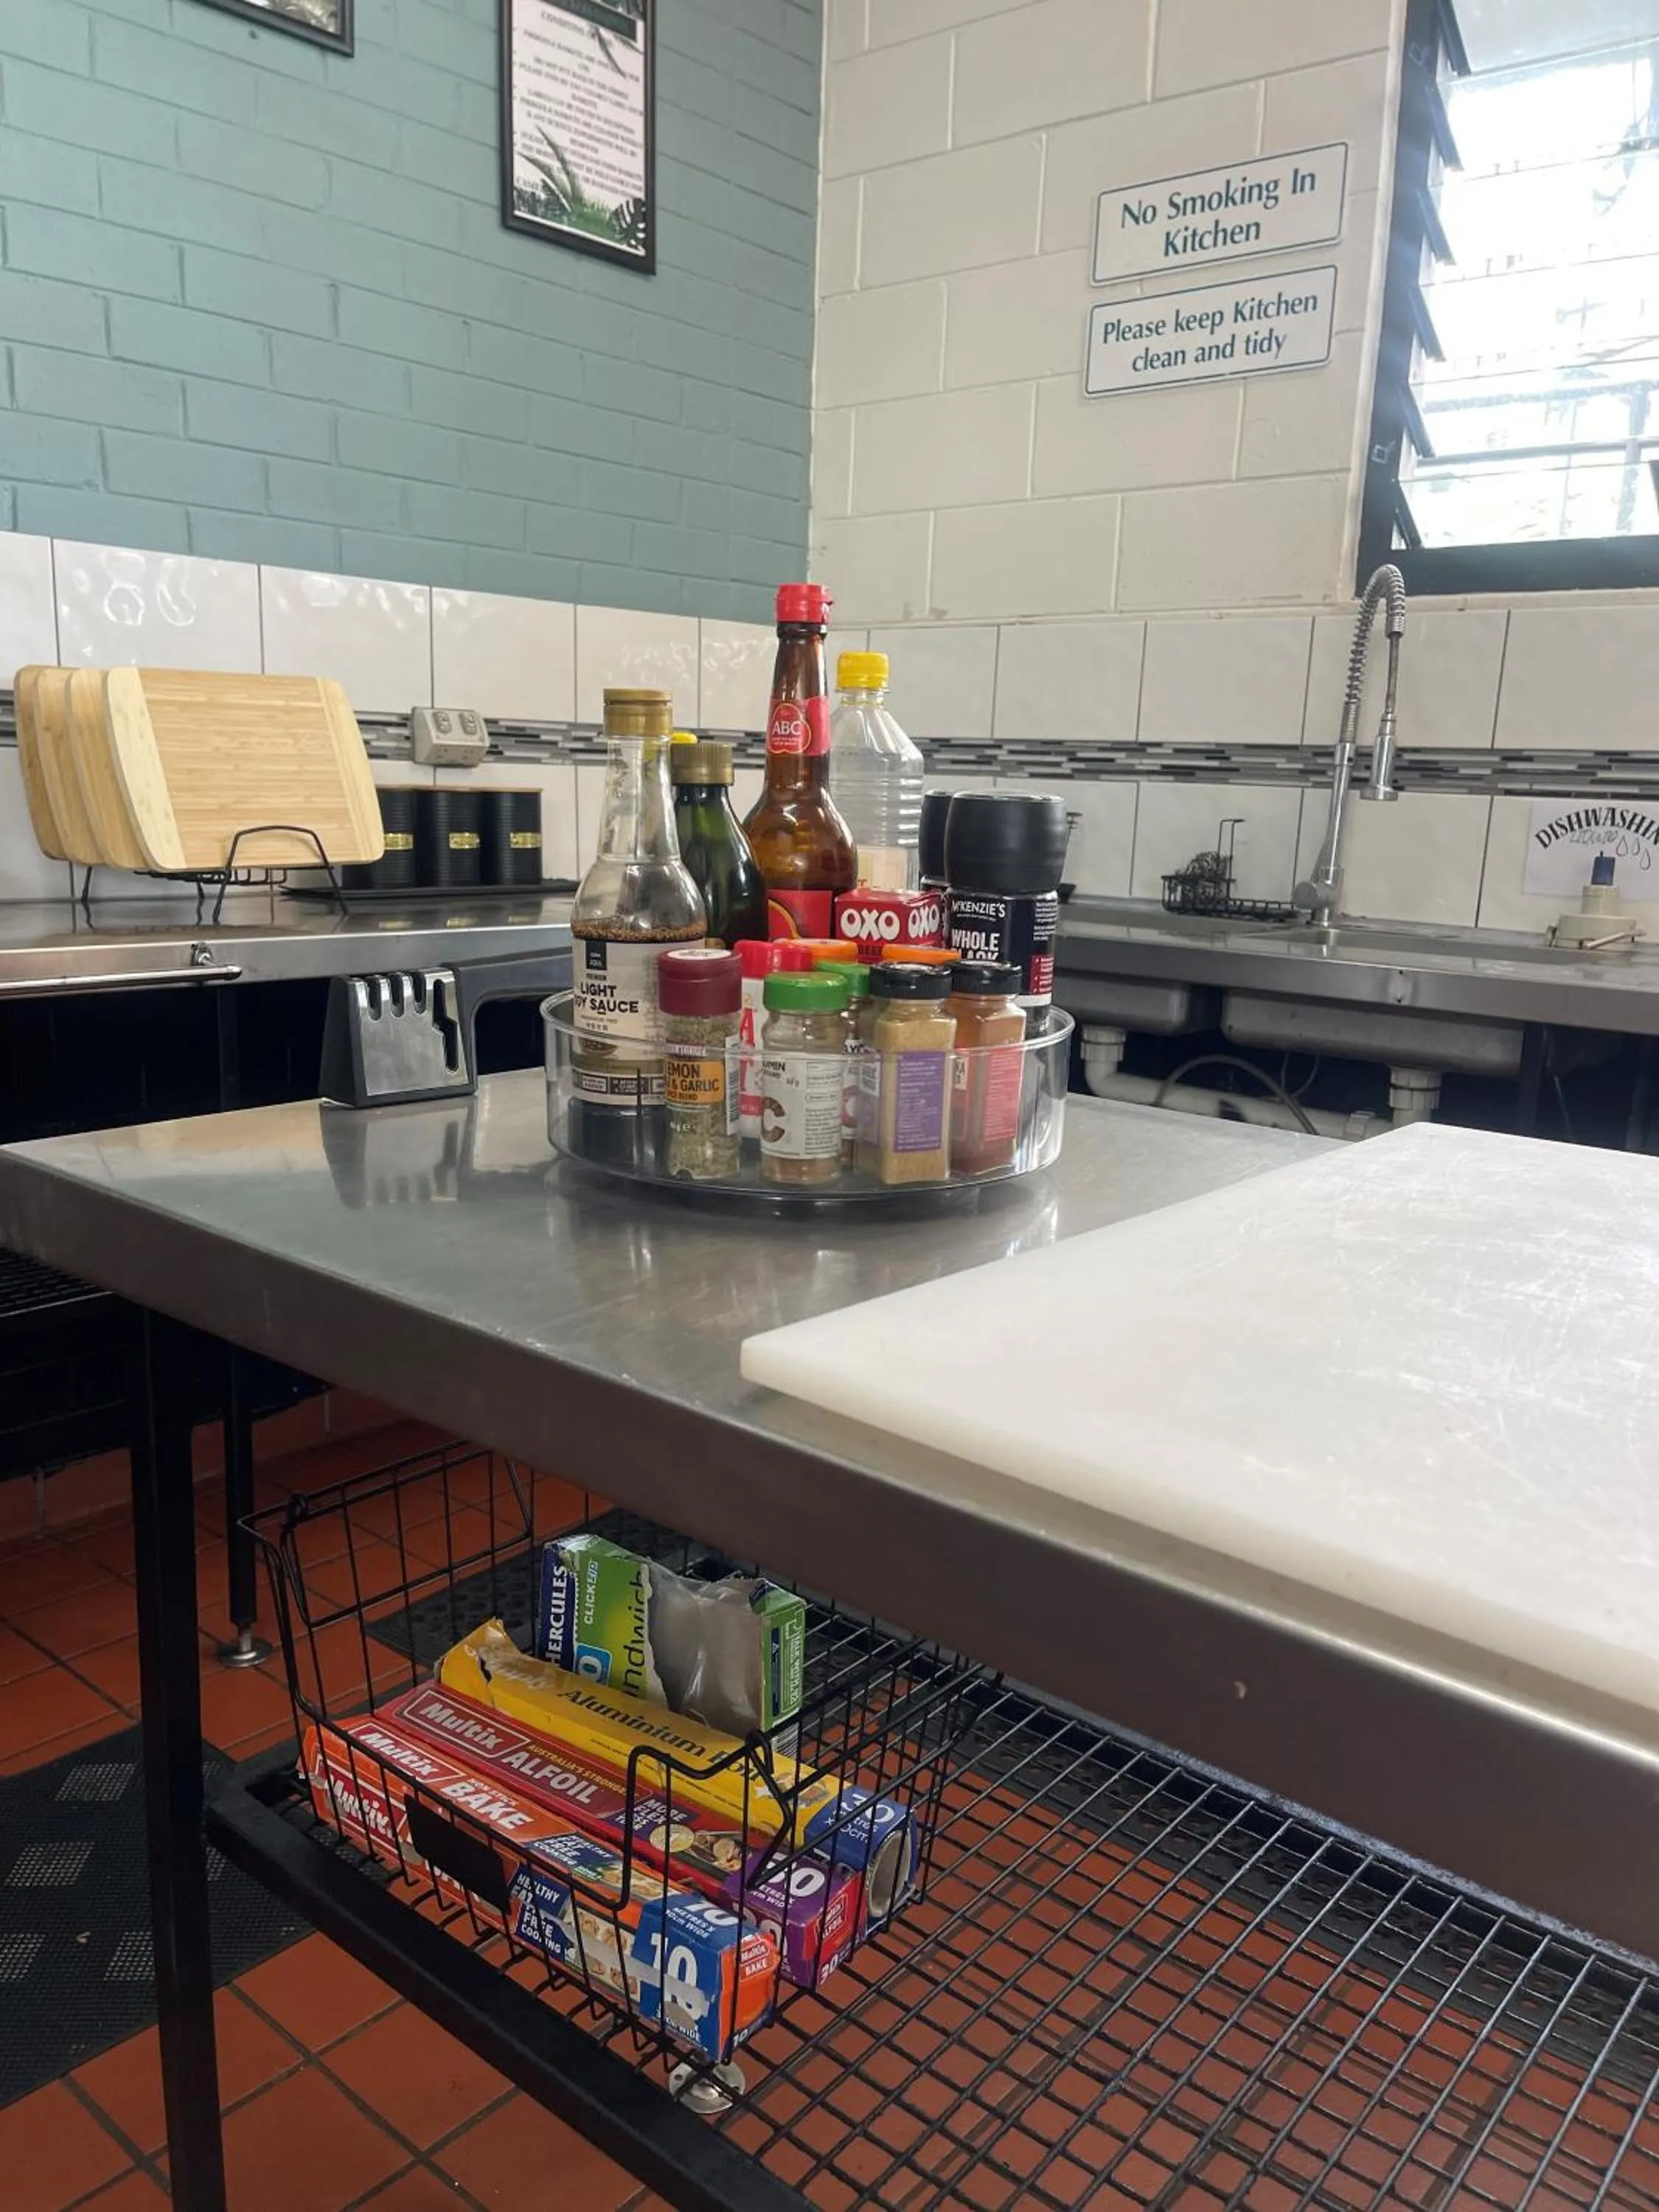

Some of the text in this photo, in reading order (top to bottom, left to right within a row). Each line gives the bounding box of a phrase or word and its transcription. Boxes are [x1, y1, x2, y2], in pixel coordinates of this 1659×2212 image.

[1121, 168, 1316, 229] No Smoking In
[1164, 219, 1261, 257] Kitchen
[1103, 292, 1318, 344] Please keep Kitchen
[1132, 328, 1287, 372] clean and tidy
[773, 720, 801, 735] ABC
[841, 908, 900, 941] OXO
[908, 904, 940, 939] OXO
[952, 929, 1001, 951] WHOLE
[580, 982, 617, 998] LIGHT
[590, 998, 639, 1014] SAUCE
[667, 1062, 700, 1078] EMON
[681, 1079, 720, 1092] GARLIC
[762, 1062, 785, 1072] UMIN
[545, 1565, 567, 1664] HERCULES
[622, 1571, 645, 1697] ndwich
[419, 1703, 504, 1750] Multix
[559, 1688, 706, 1758] Aluminium
[358, 1733, 439, 1776] Multix
[501, 1751, 599, 1804] ALFOIL
[440, 1781, 535, 1830] BAKE
[518, 1873, 560, 1903] HELTHY
[650, 1933, 698, 1988] 10
[745, 1958, 768, 1977] BAKE
